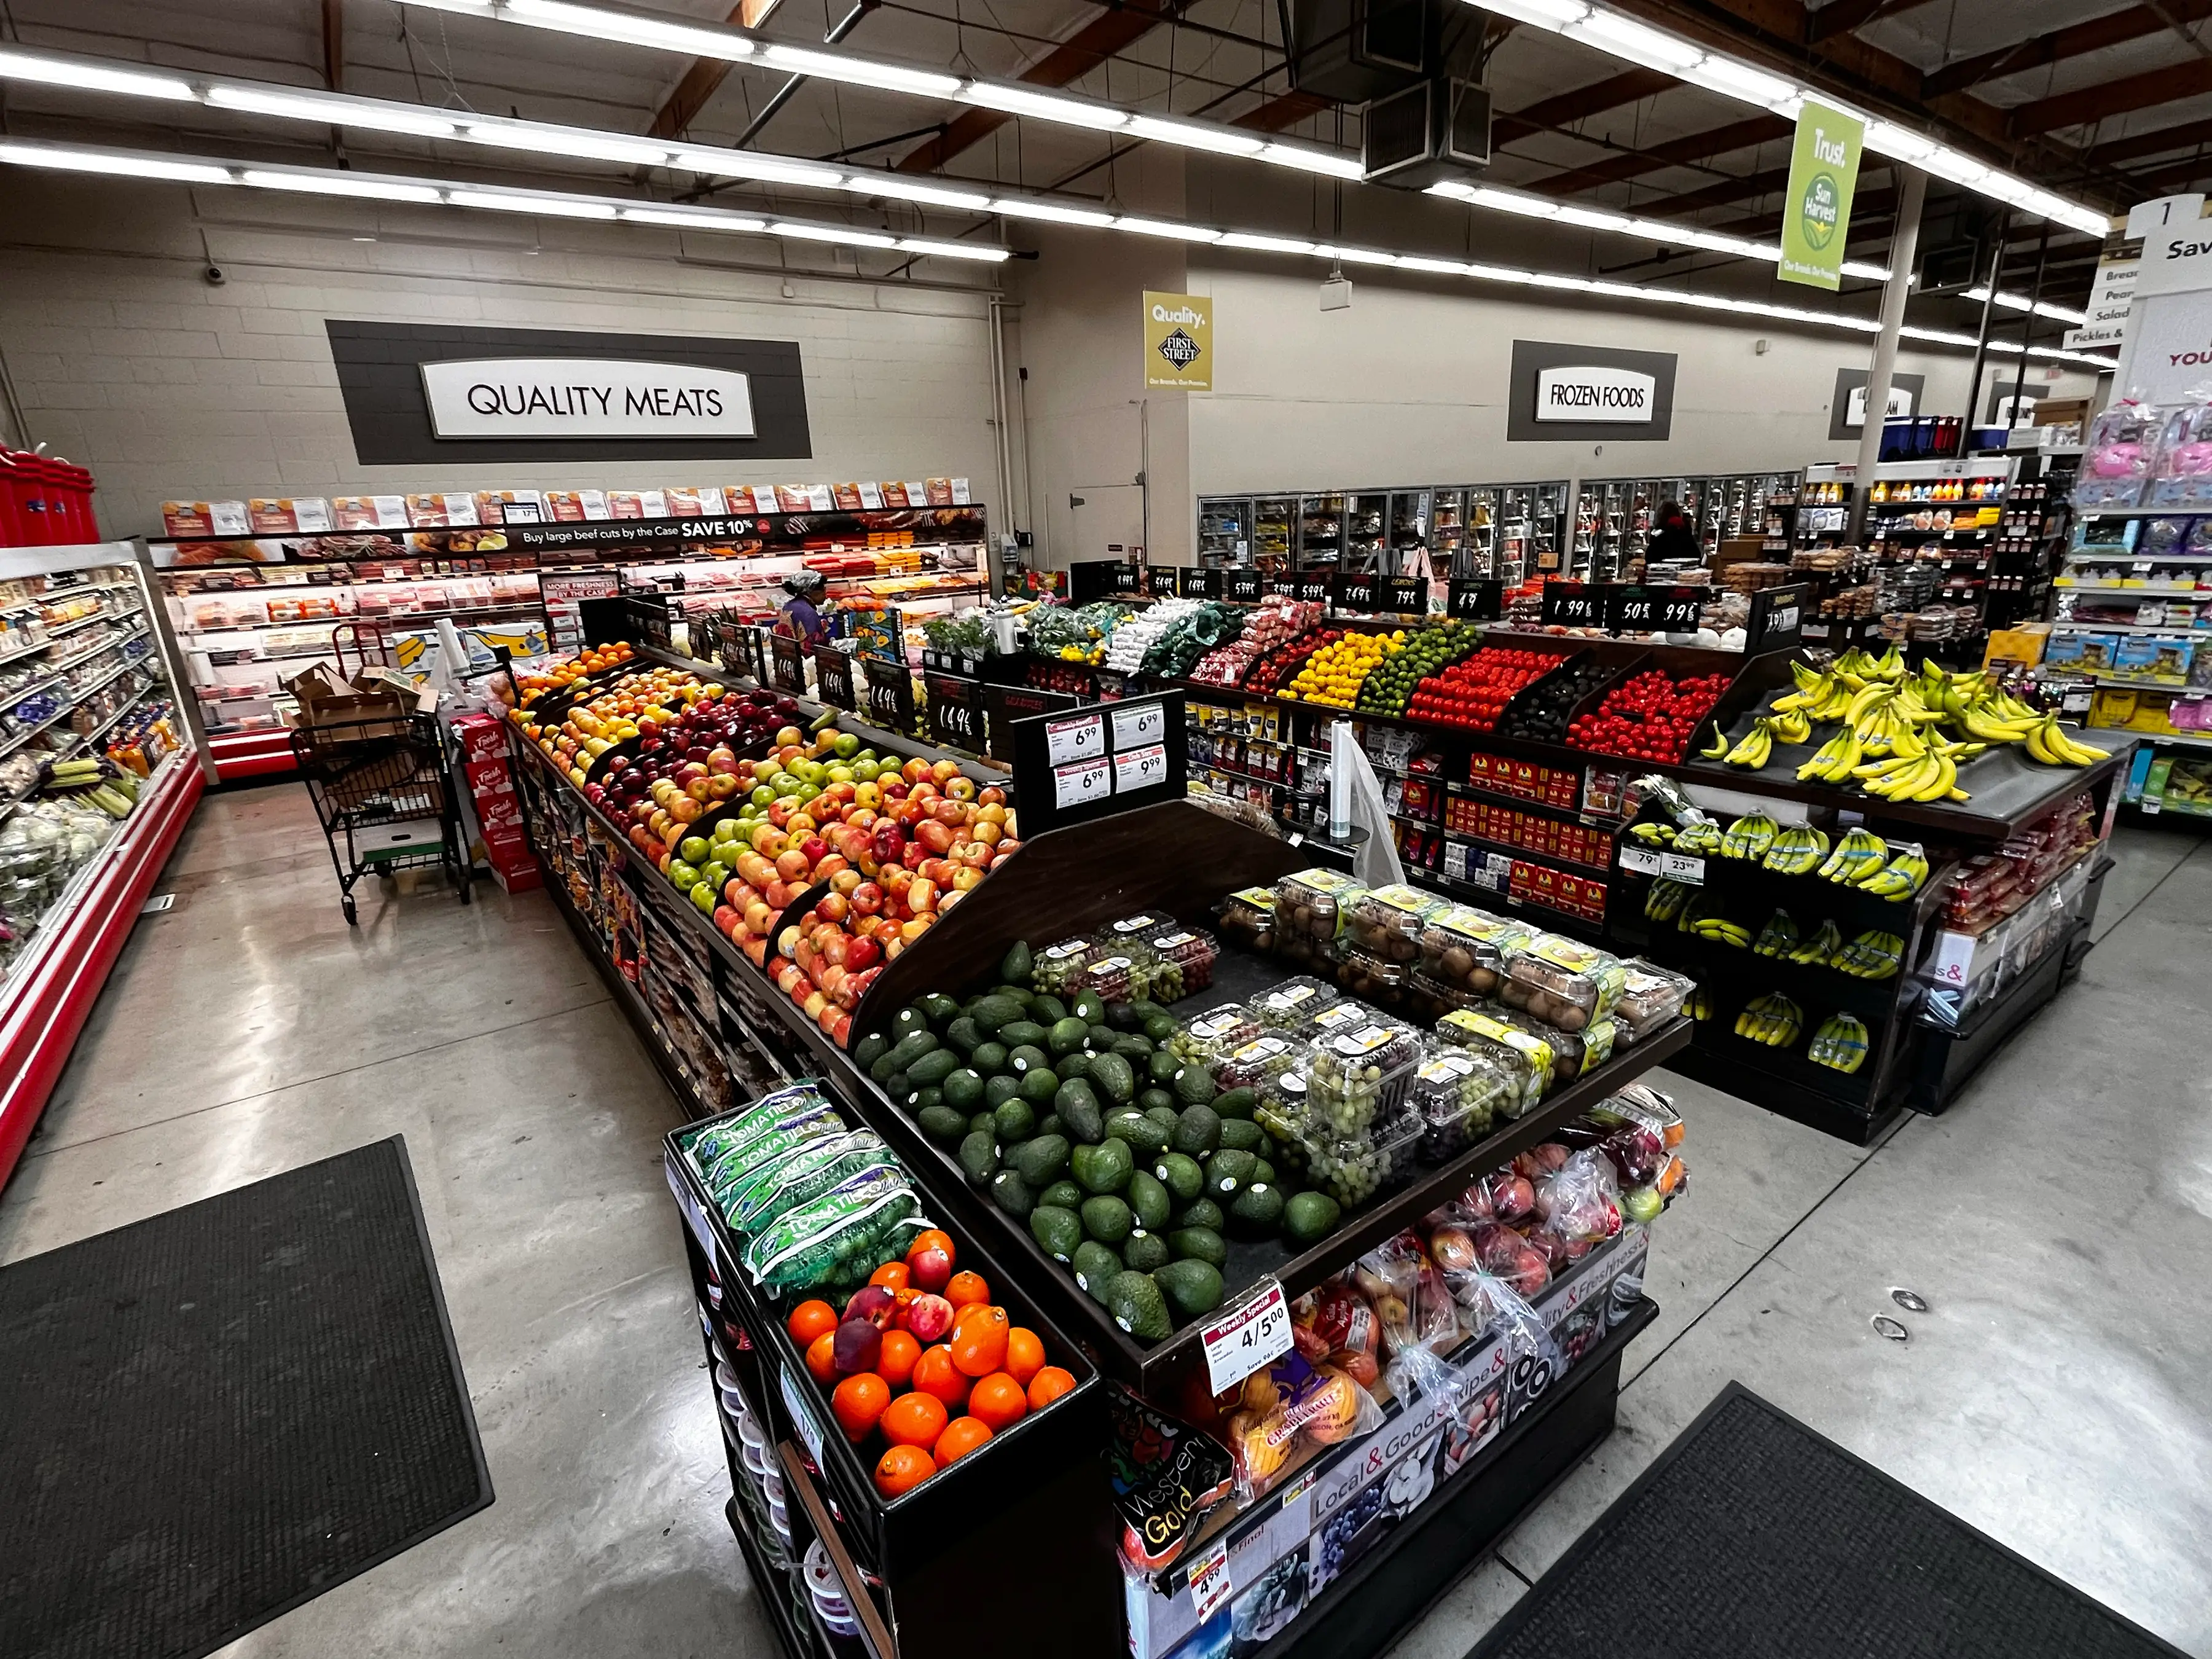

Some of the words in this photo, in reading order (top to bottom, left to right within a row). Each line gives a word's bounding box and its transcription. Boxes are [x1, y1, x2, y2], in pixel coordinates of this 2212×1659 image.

[1814, 127, 1845, 169] Trust.
[1815, 182, 1832, 205] Sun
[1805, 196, 1836, 223] Harvest
[2161, 202, 2171, 226] 1
[1152, 304, 1206, 329] Quality.
[1167, 337, 1192, 349] FIRST
[2073, 331, 2110, 342] Pickles
[1163, 348, 1196, 360] STREET
[468, 383, 613, 416] QUALITY
[625, 386, 723, 417] MEATS
[1550, 384, 1600, 407] FROZEN
[1602, 386, 1644, 408] FOODS
[523, 532, 543, 544] Buy
[546, 531, 572, 543] large
[575, 528, 598, 539] beef
[600, 529, 621, 538] cuts
[622, 528, 635, 538] by
[637, 527, 653, 536] the
[655, 526, 678, 536] Case
[681, 521, 725, 537] SAVE
[727, 519, 753, 535] 10%
[571, 581, 614, 589] FRESHNESS
[476, 731, 499, 747] Fresh
[477, 766, 501, 783] Fresh
[488, 799, 512, 817] Fresh
[1946, 964, 1963, 982] &
[1217, 1313, 1247, 1336] Weekly
[1246, 1295, 1271, 1318] Special
[1326, 1303, 1336, 1321] Gala
[1247, 1359, 1262, 1371] Save
[1315, 1462, 1364, 1519] Local
[1366, 1446, 1383, 1475] &
[1385, 1409, 1435, 1459] Good
[1491, 1347, 1505, 1373] &
[1124, 1435, 1212, 1517] Western
[1145, 1484, 1193, 1544] Gold
[1238, 1524, 1265, 1552] Final
[1200, 1568, 1220, 1595] 499
